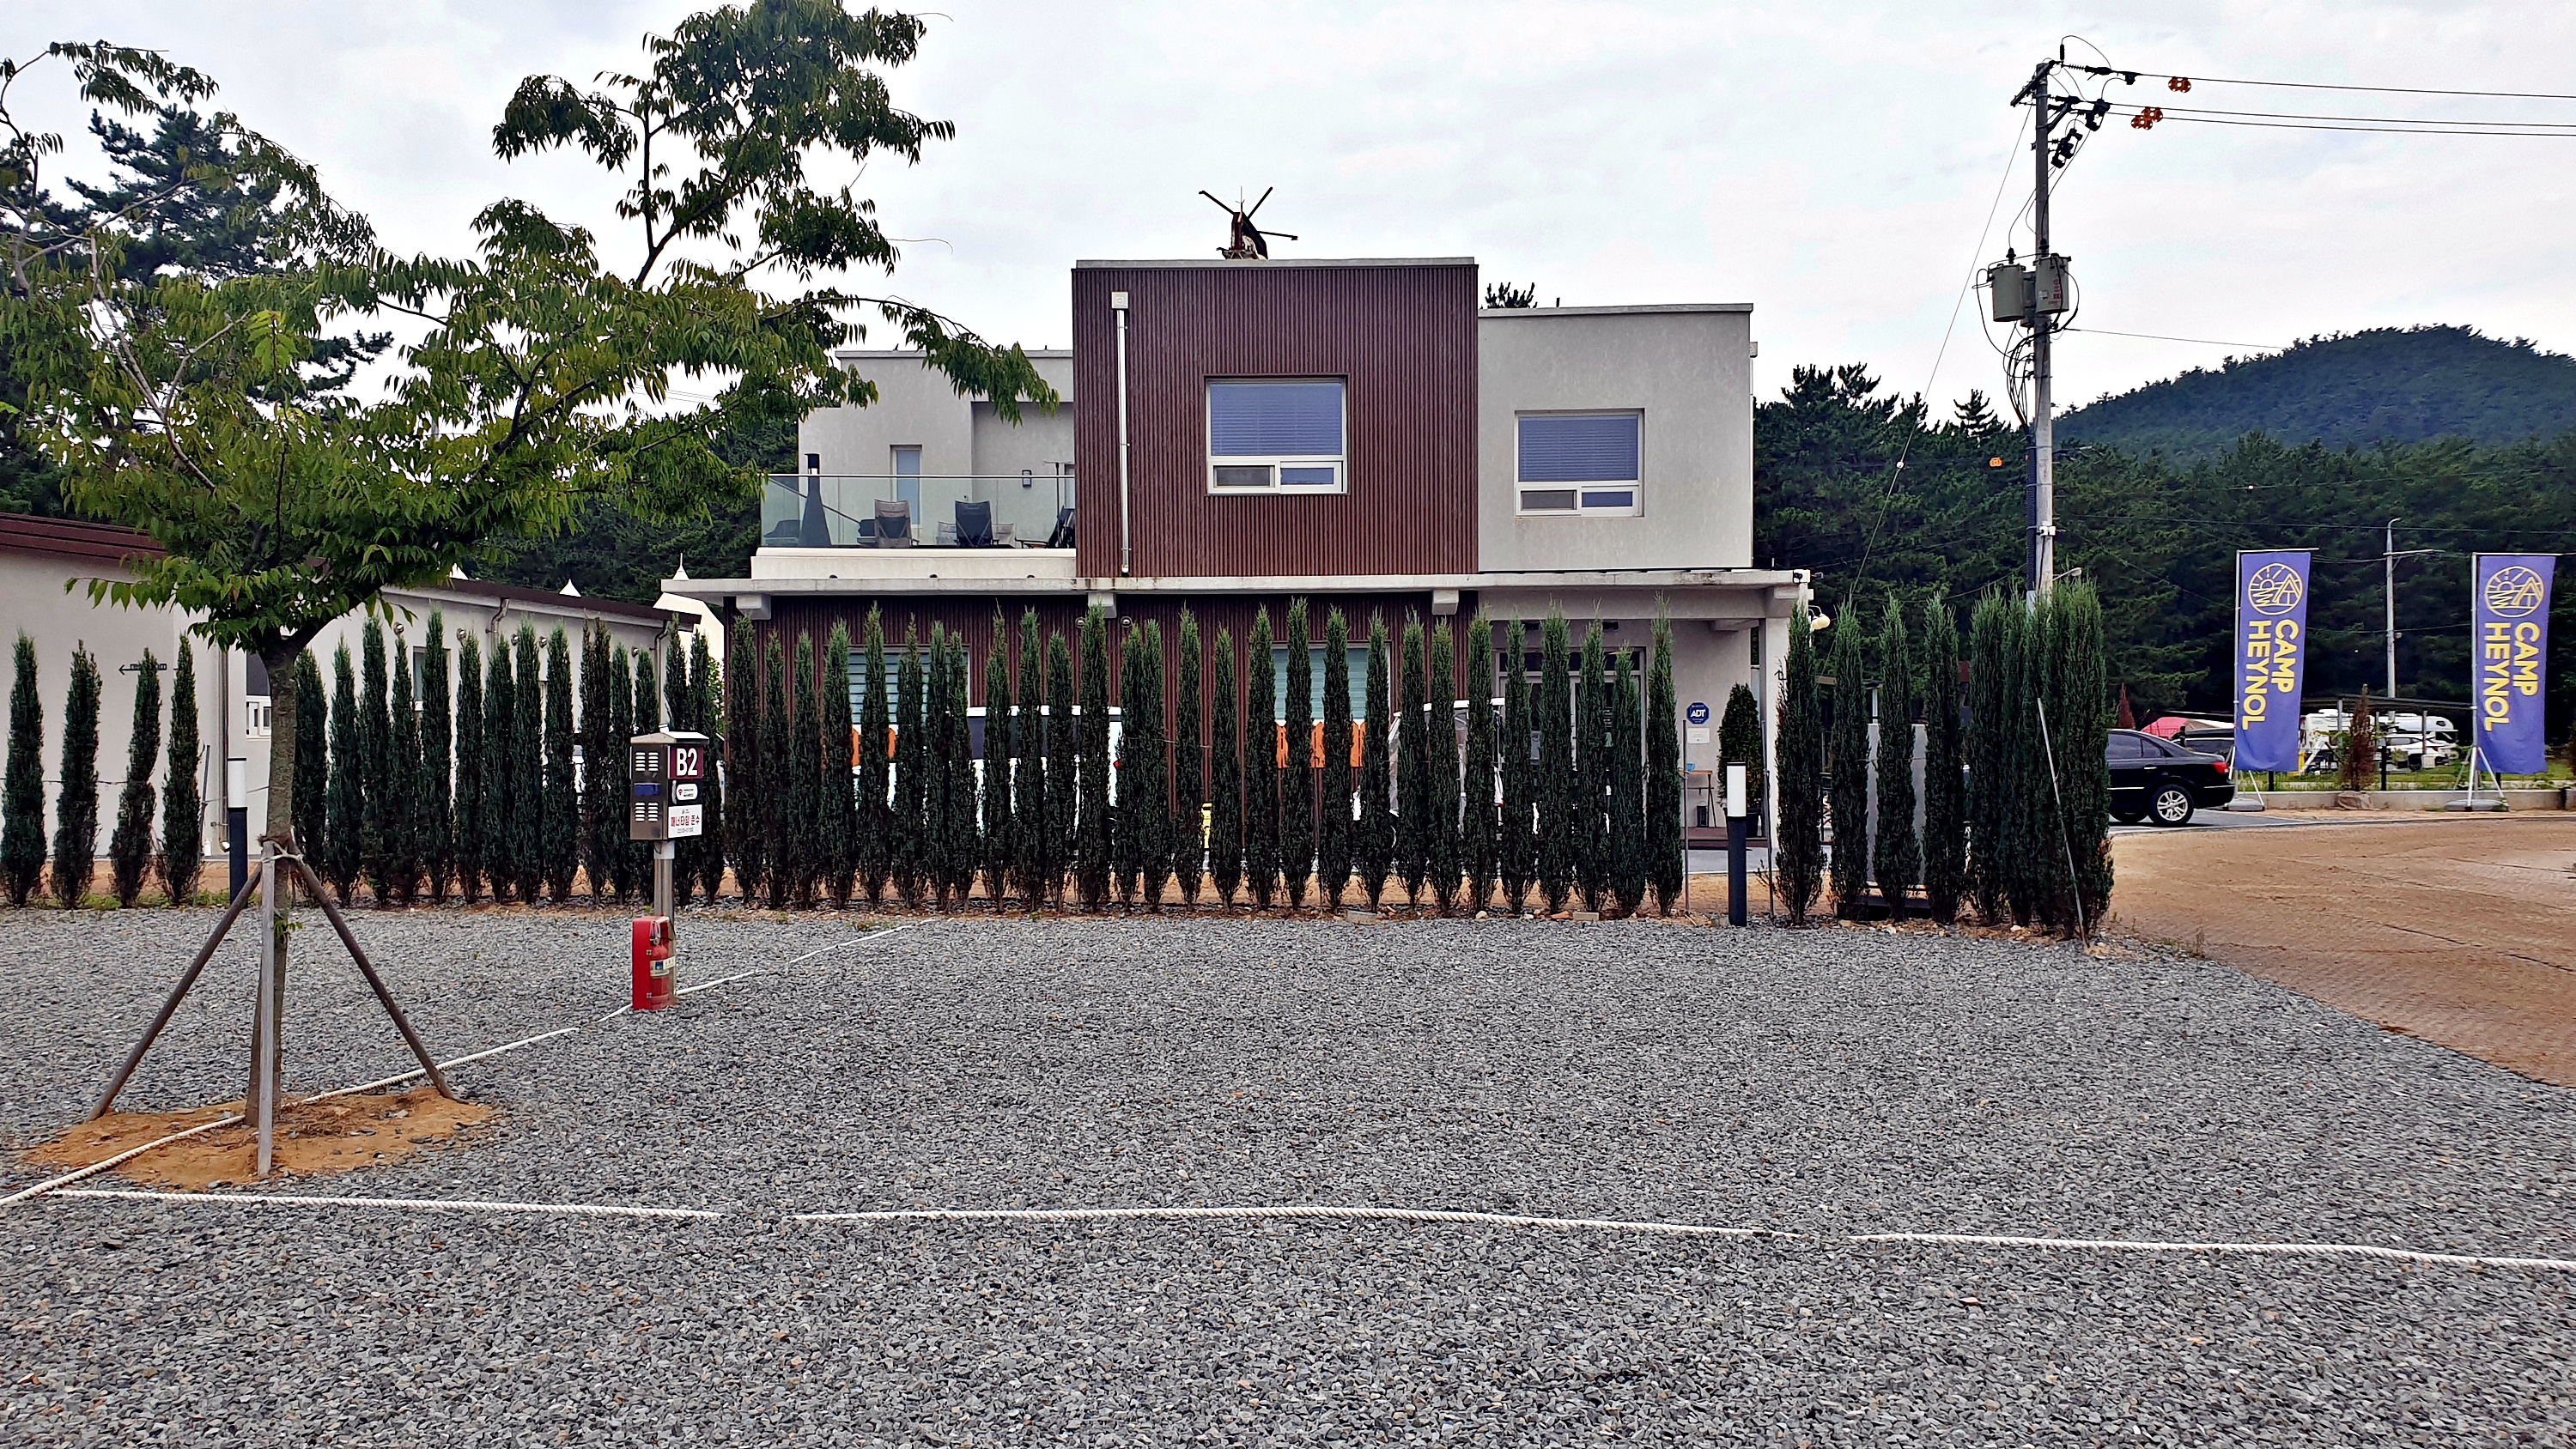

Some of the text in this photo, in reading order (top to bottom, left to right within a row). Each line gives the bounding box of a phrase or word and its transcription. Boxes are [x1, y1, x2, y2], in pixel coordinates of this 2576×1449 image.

[2242, 620, 2272, 730] HEYNOL
[2270, 619, 2300, 693] CAMP
[2483, 622, 2511, 731] HEYNOL
[2512, 621, 2541, 696] CAMP
[676, 748, 698, 776] B2
